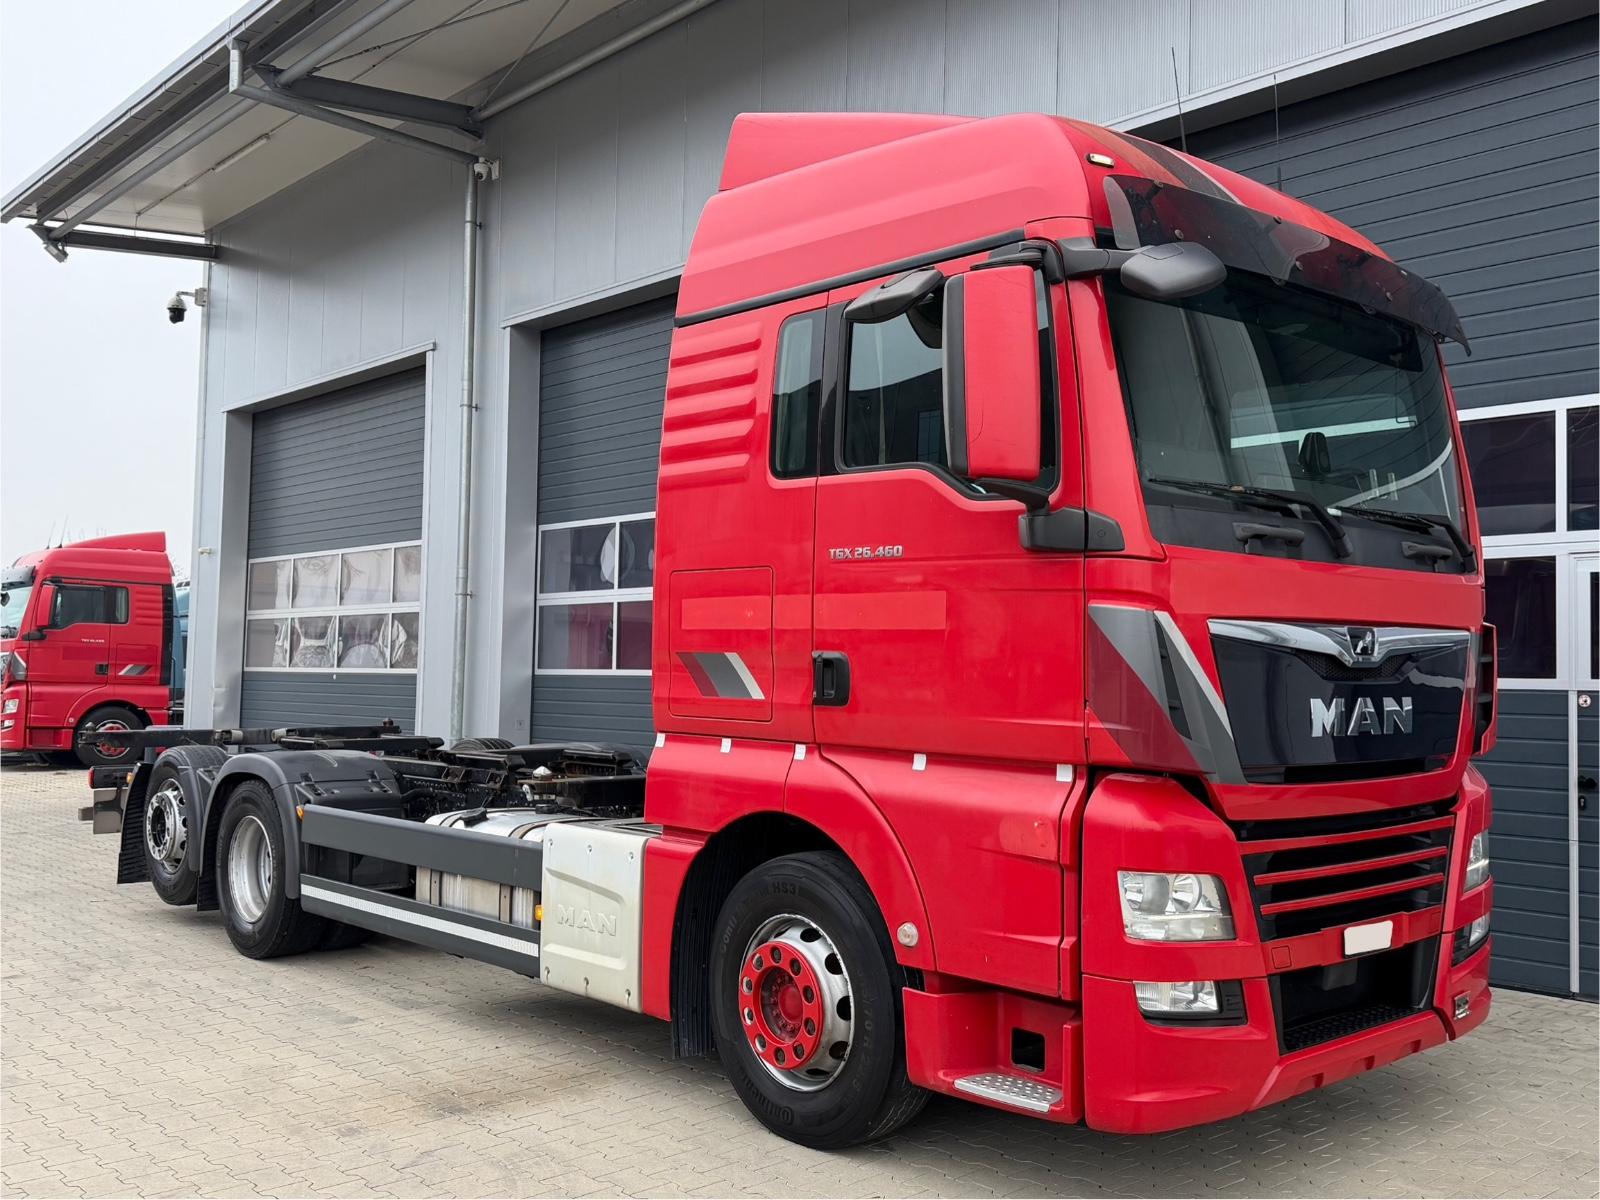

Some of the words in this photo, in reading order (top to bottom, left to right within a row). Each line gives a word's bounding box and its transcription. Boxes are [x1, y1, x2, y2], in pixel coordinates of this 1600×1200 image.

[829, 547, 853, 560] TGX
[854, 545, 904, 559] 26.460
[1310, 696, 1413, 738] MAN
[557, 903, 617, 937] MAN
